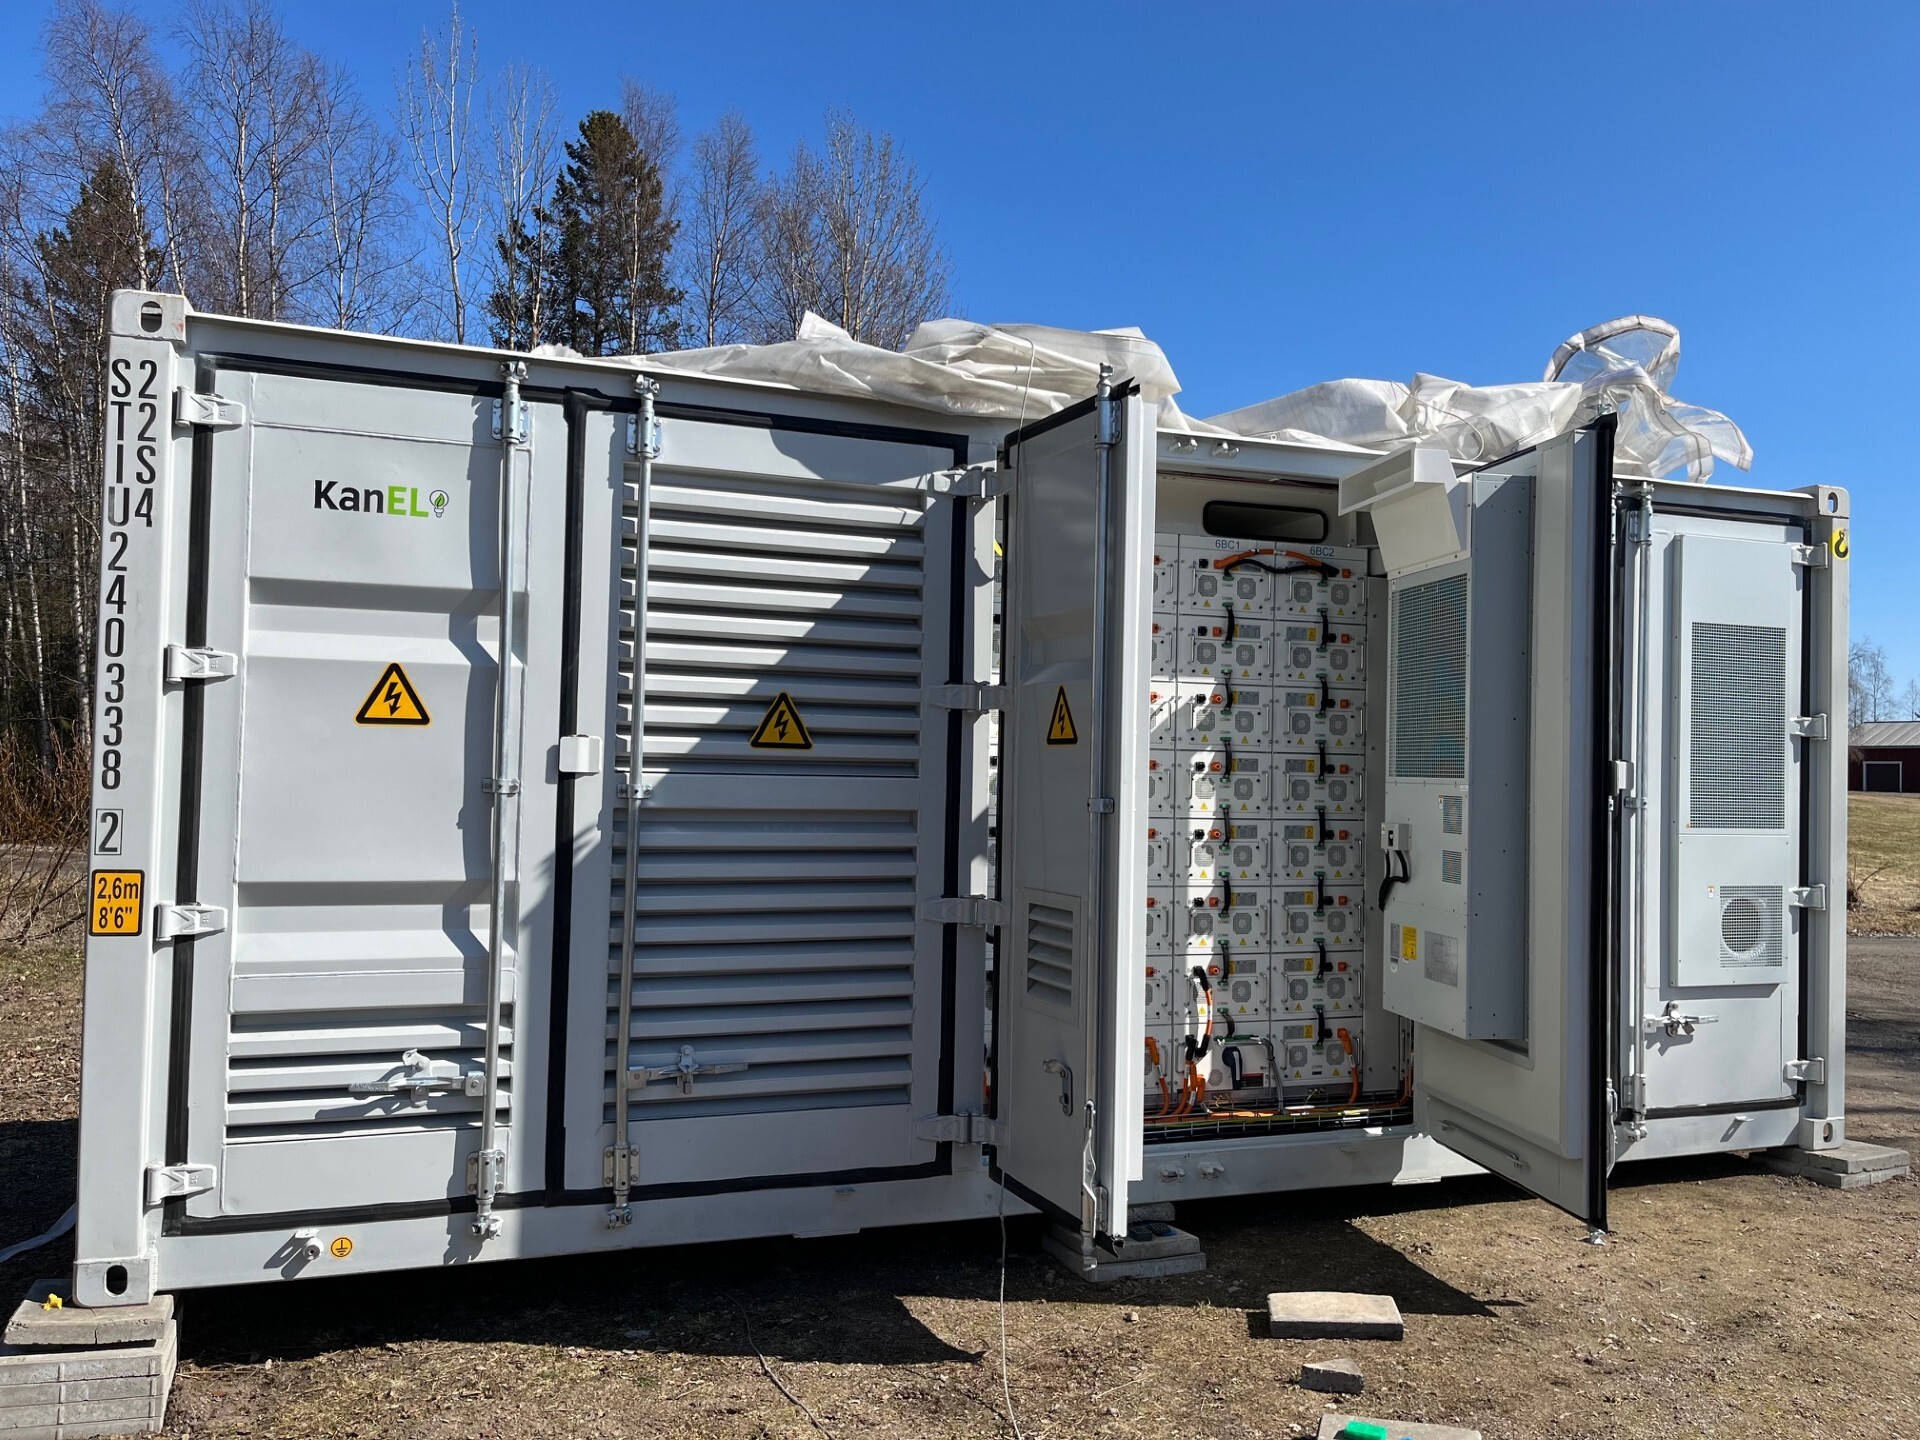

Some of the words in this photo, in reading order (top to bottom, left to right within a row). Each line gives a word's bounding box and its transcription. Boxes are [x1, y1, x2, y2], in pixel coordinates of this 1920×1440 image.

[134, 358, 158, 528] 22S4
[313, 479, 430, 518] KanEL
[1215, 539, 1240, 550] 6BC1
[1310, 546, 1335, 557] 6BC2
[97, 877, 139, 903] 2,6m
[98, 906, 133, 929] 8'6"
